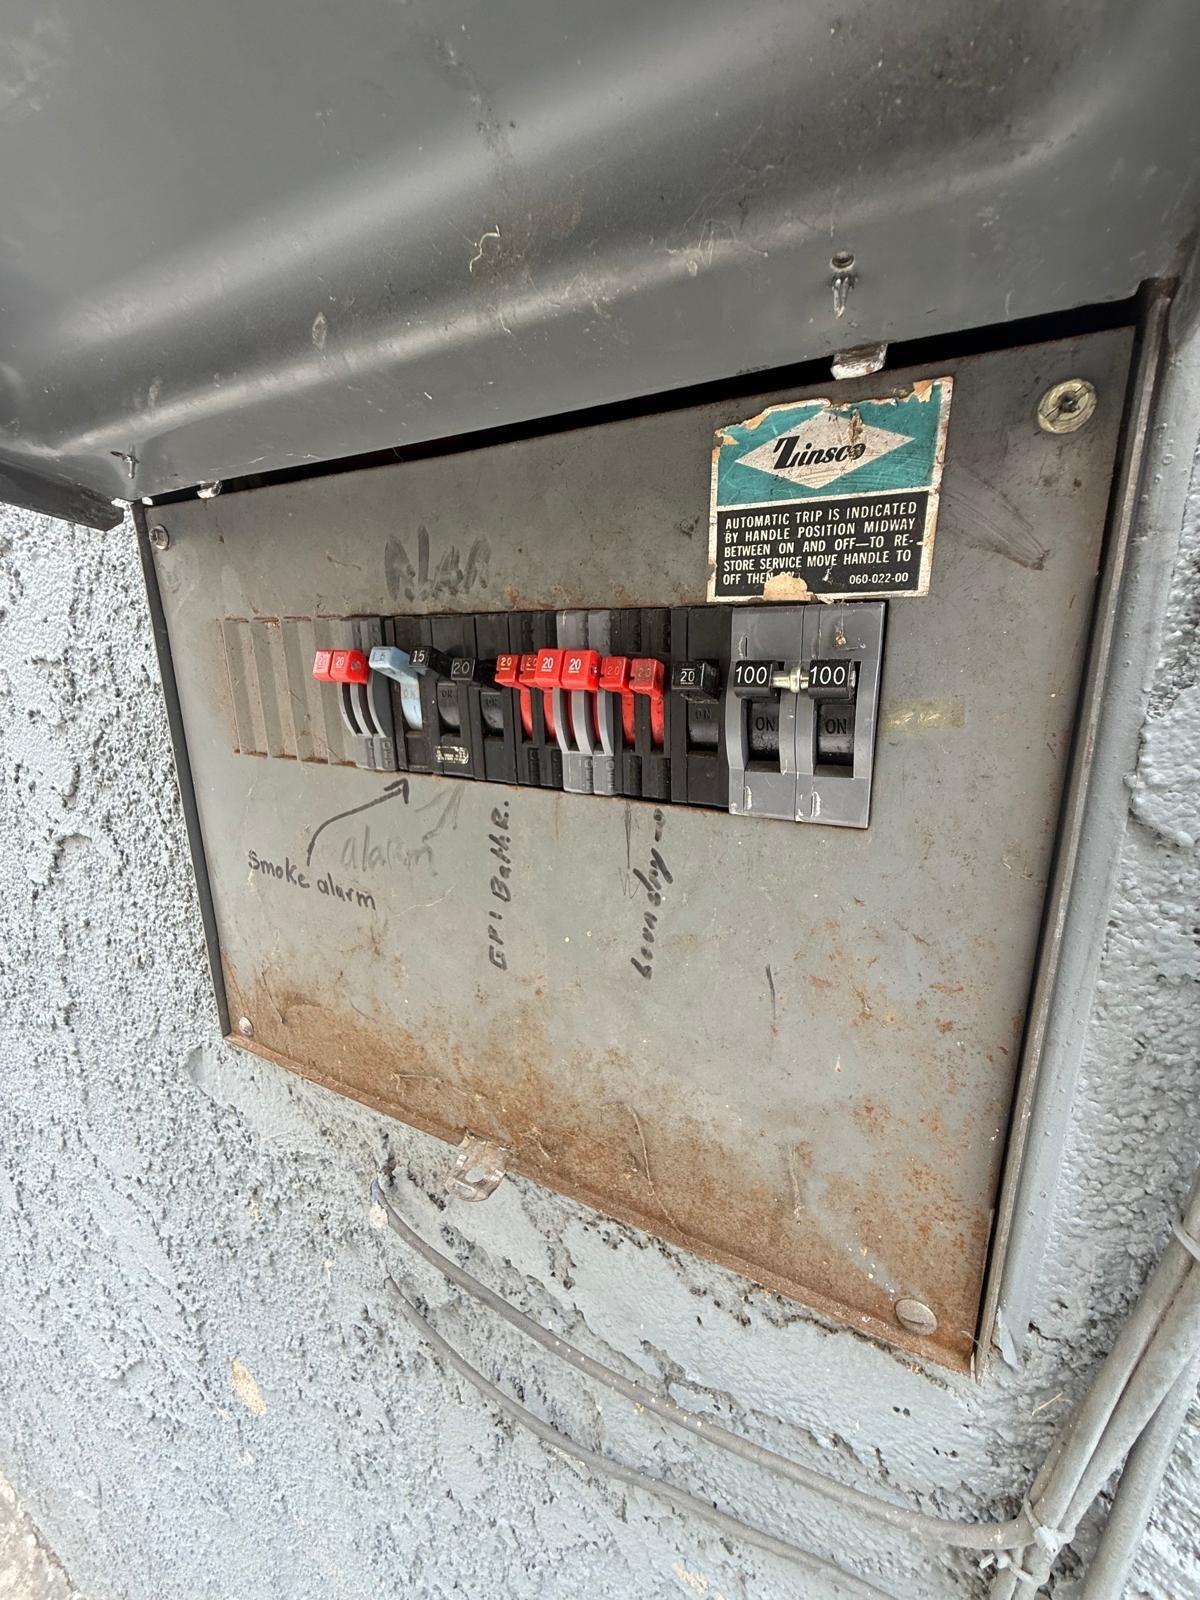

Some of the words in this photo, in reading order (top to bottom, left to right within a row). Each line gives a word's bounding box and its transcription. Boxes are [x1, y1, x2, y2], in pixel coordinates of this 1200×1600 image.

[725, 513, 790, 530] AUTOMATIC
[795, 510, 823, 524] TRIP
[828, 508, 840, 521] IS
[846, 501, 917, 518] INDICATED
[724, 531, 739, 543] BY
[745, 526, 790, 542] HANDLE
[797, 521, 855, 538] POSITION
[863, 517, 916, 534] MIDWAY
[724, 544, 771, 558] BETWEEN
[778, 542, 795, 554] ON
[803, 540, 826, 552] AND
[894, 533, 914, 545] RE-
[723, 559, 755, 572] STORE
[759, 556, 802, 570] SERVICE
[806, 554, 838, 568] MOVE
[843, 549, 890, 565] HANDLE
[896, 547, 912, 562] TO
[722, 574, 741, 585] OFF
[747, 573, 774, 585] THEN
[335, 656, 345, 667] 20
[412, 650, 425, 663] 15
[500, 656, 513, 667] 20
[542, 656, 555, 670] 20
[569, 657, 582, 671] 20
[452, 660, 471, 675] 20
[606, 664, 622, 676] 20
[735, 665, 768, 685] 100
[680, 670, 696, 683] 20
[810, 665, 845, 686] 100
[755, 717, 776, 732] ON
[825, 718, 847, 735] ON
[316, 872, 377, 911] alarm
